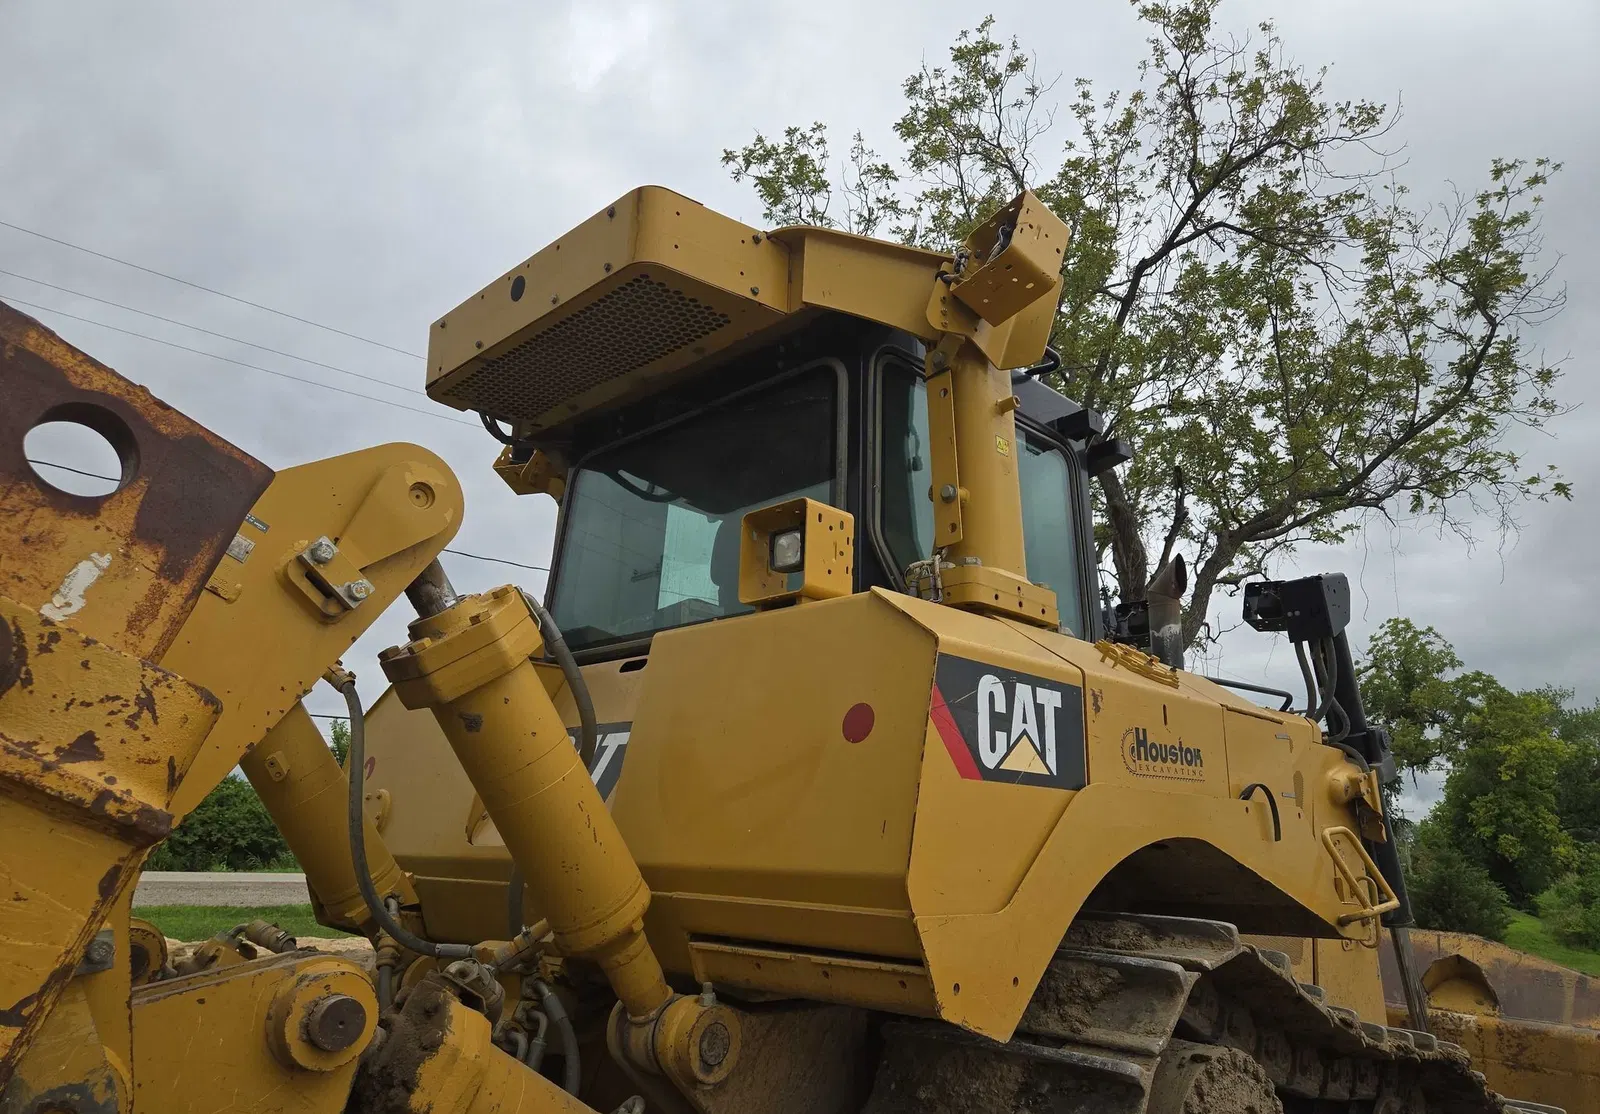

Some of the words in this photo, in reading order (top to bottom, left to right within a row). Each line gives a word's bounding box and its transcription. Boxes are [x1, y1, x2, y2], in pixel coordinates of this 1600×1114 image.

[977, 674, 1062, 776] CAT
[1134, 726, 1204, 768] Houston
[1138, 763, 1204, 777] EXCAVATING
